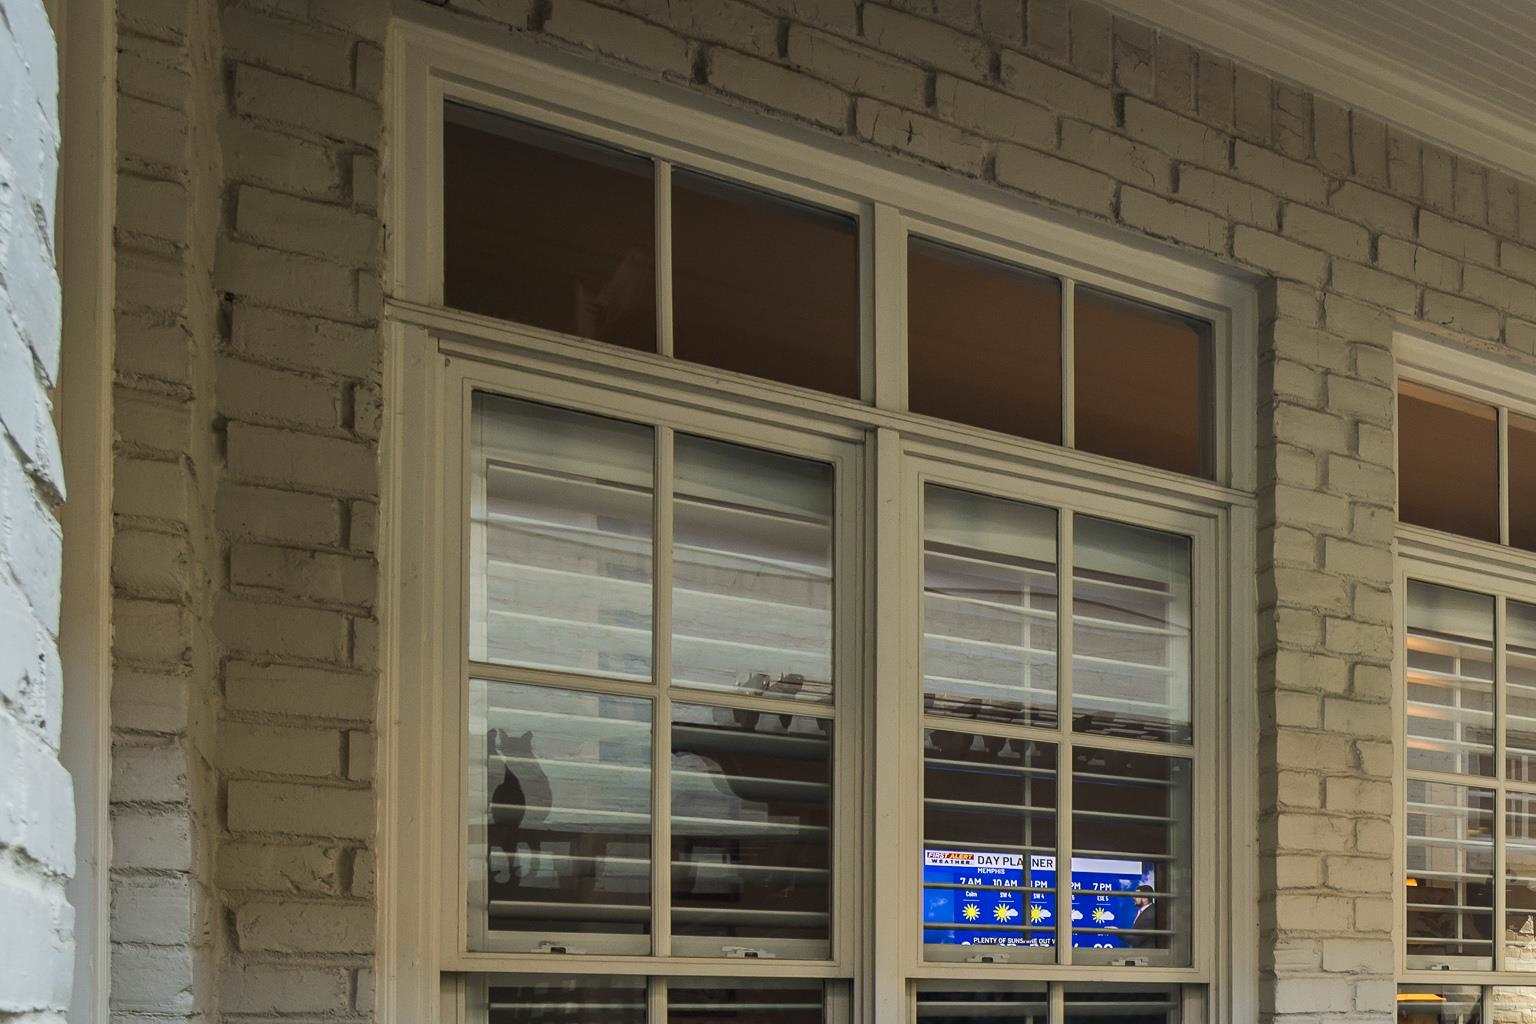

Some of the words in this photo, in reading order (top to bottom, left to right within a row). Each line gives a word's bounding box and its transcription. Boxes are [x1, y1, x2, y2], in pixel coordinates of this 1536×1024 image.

[977, 855, 1000, 866] DAY
[1003, 856, 1053, 868] PLANER
[977, 867, 1006, 875] MEMPHIS
[960, 877, 965, 885] 7
[967, 877, 982, 886] AM
[993, 878, 1002, 886] 10
[1004, 879, 1018, 887] AM
[1034, 880, 1048, 888] PM
[1093, 882, 1098, 890] 7
[1099, 882, 1112, 891] PM
